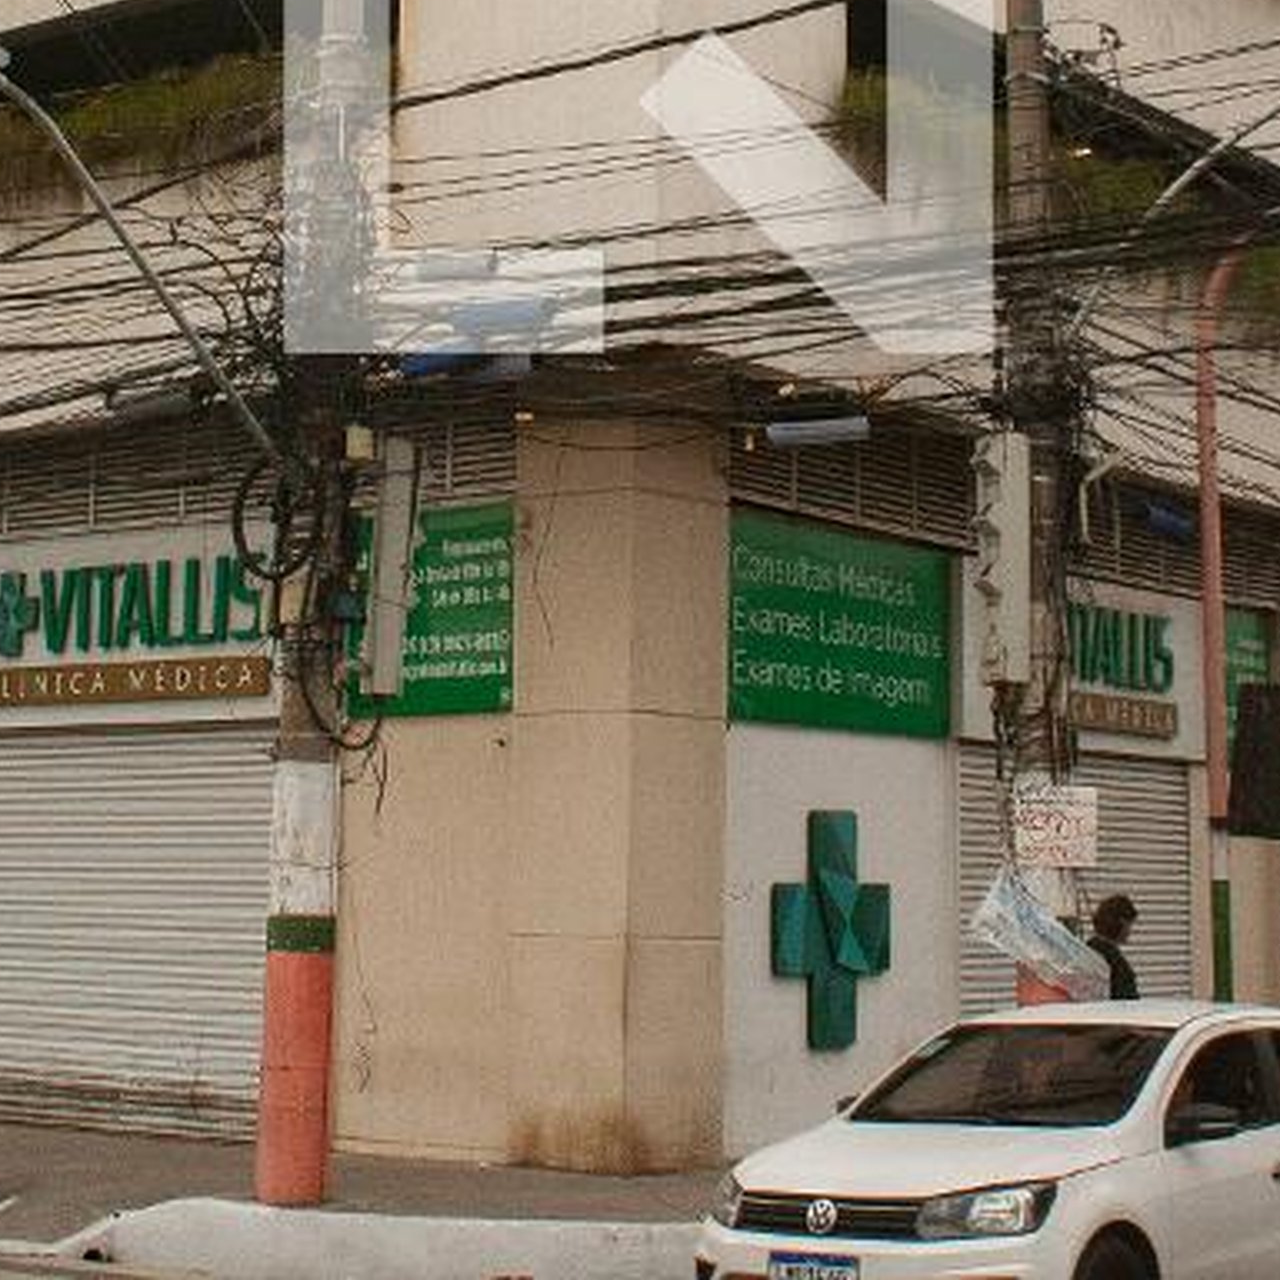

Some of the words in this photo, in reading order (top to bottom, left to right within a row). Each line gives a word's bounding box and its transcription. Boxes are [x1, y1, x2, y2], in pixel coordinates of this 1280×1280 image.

[39, 554, 268, 654] VITALLIS
[732, 595, 813, 641] Exames
[732, 648, 813, 692] Exames
[816, 658, 844, 695] de
